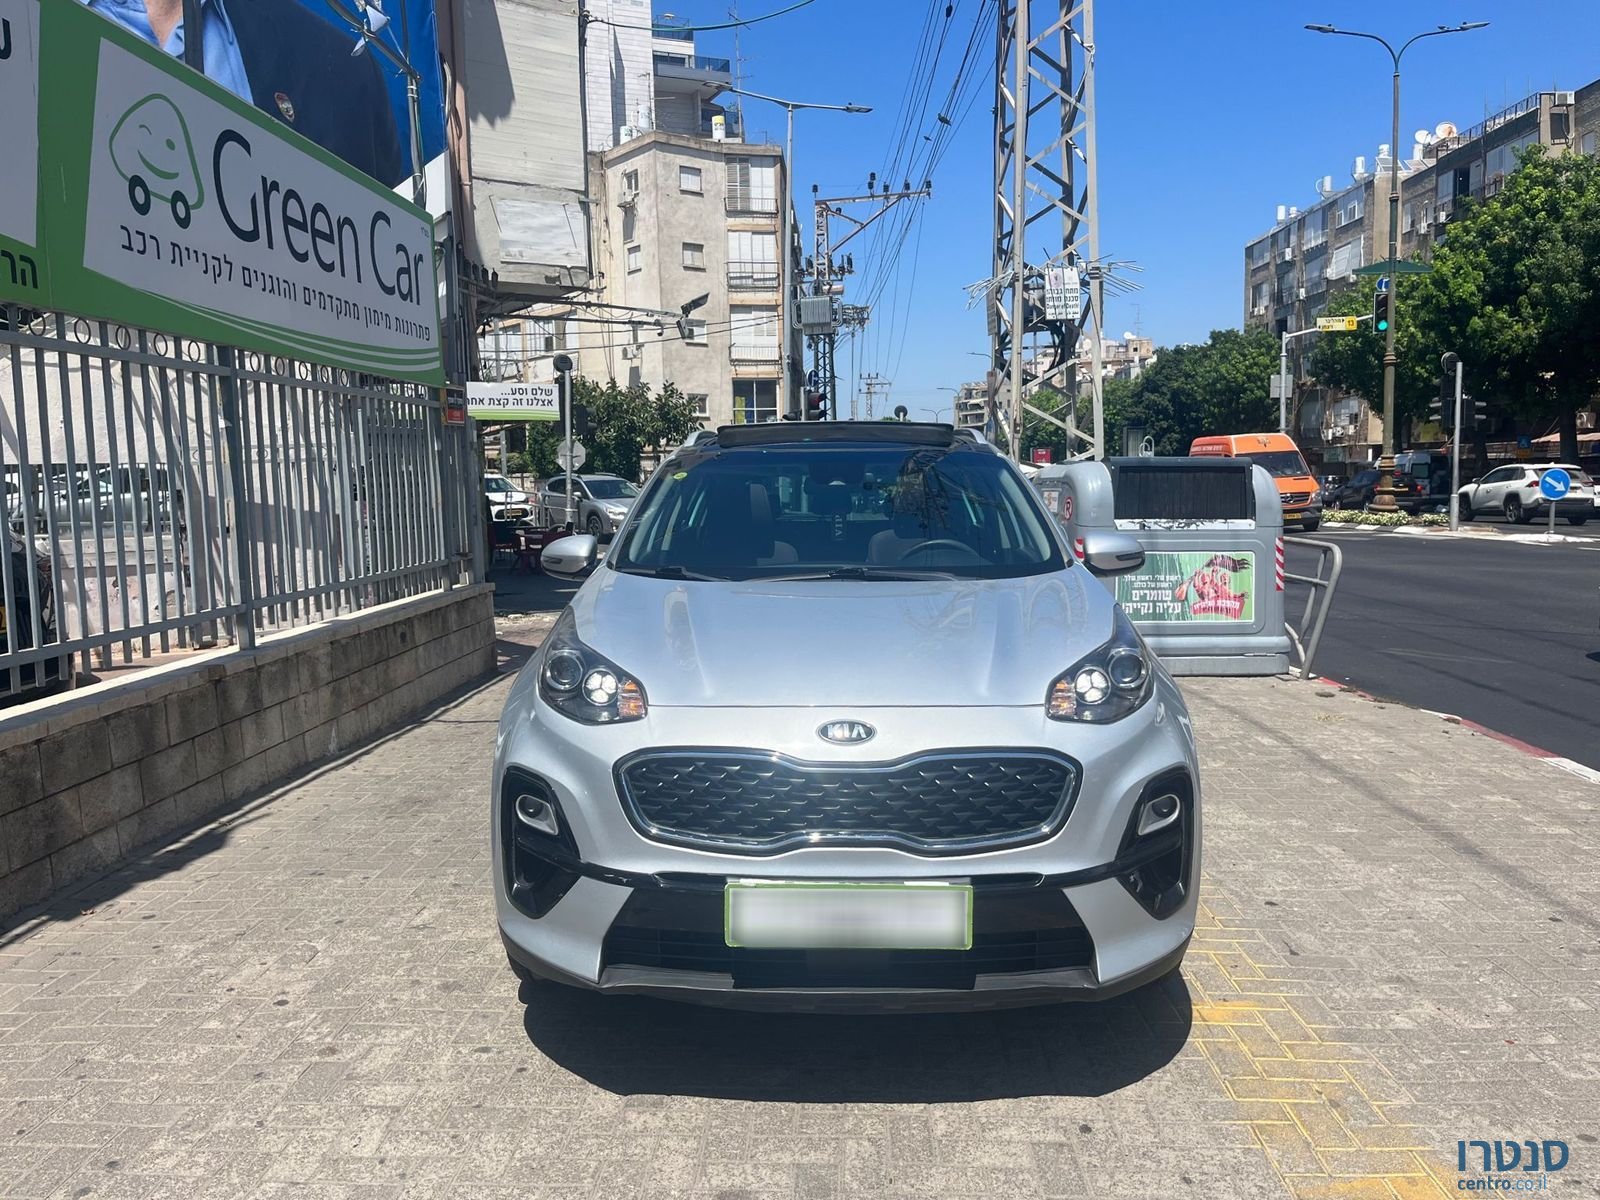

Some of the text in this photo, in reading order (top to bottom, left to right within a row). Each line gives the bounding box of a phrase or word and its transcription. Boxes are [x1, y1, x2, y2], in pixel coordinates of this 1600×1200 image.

[213, 128, 424, 306] Green Car
[120, 224, 431, 342] פתרונות מימון מתקדמים והוגנים לקניית רכב
[532, 386, 553, 396] שלם
[488, 398, 509, 408] קצת
[512, 398, 523, 406] זה
[526, 398, 553, 407] אצלנו
[1132, 589, 1172, 600] שומרים
[1156, 600, 1182, 613] עליה
[827, 723, 866, 738] KIA
